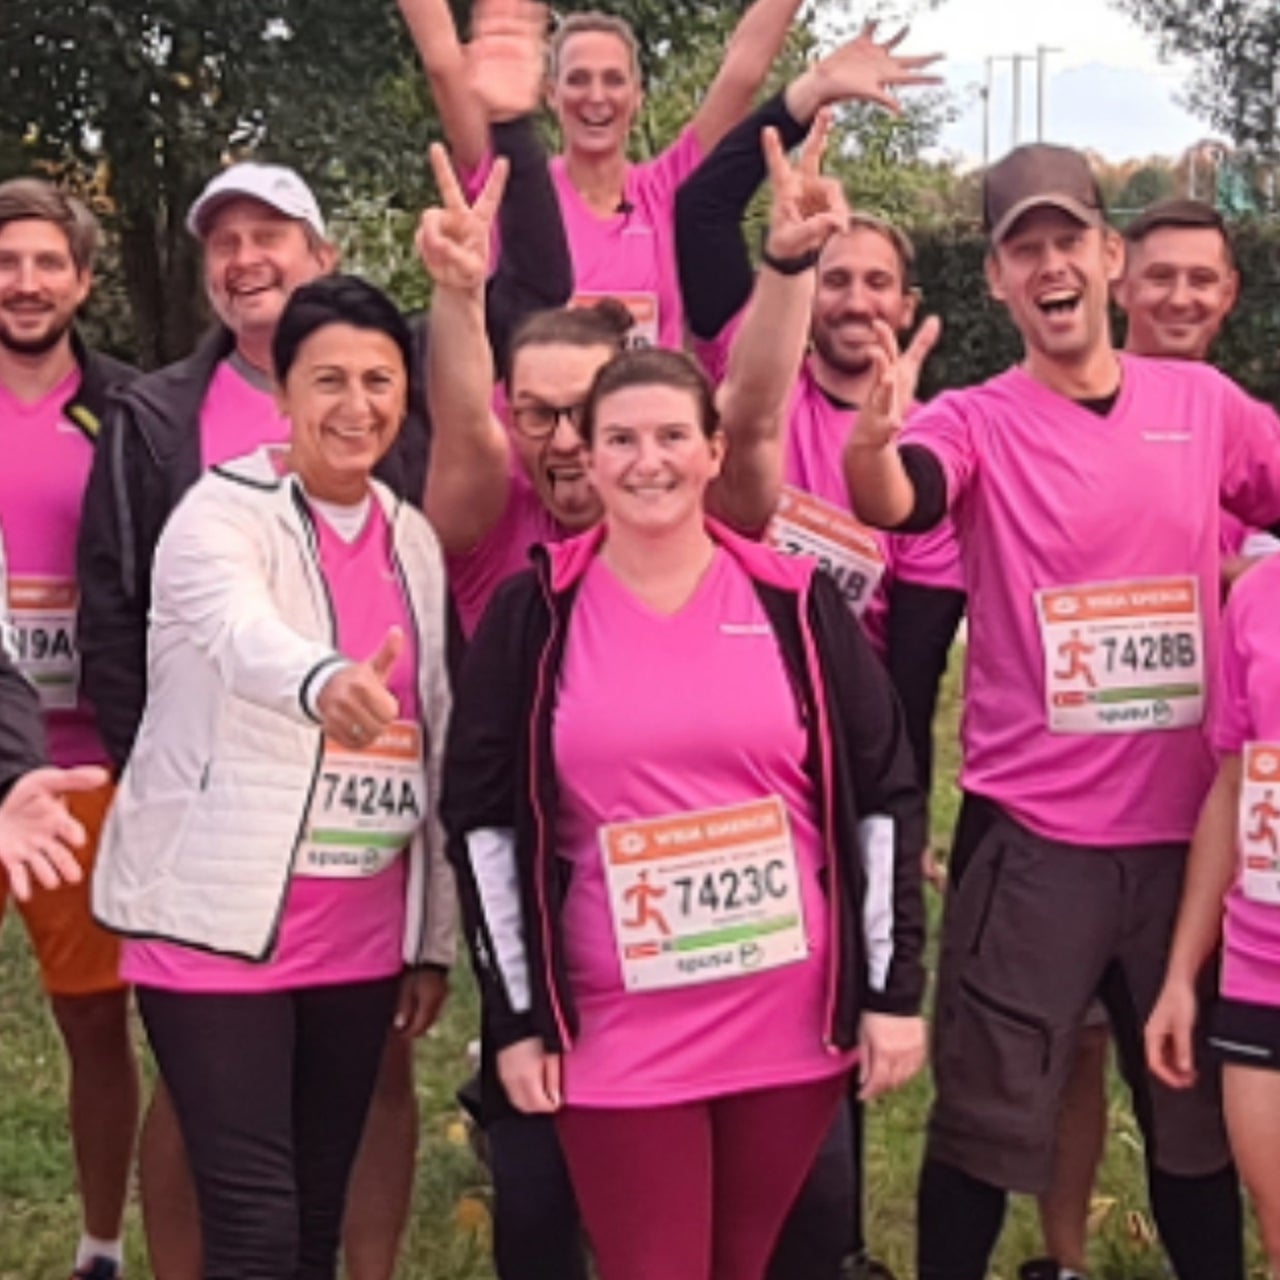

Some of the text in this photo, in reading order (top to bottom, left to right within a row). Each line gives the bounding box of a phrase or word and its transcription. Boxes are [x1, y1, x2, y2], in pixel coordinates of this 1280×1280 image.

[1100, 632, 1196, 672] 7428B
[322, 773, 420, 818] 7424A
[673, 859, 788, 916] 7423C
